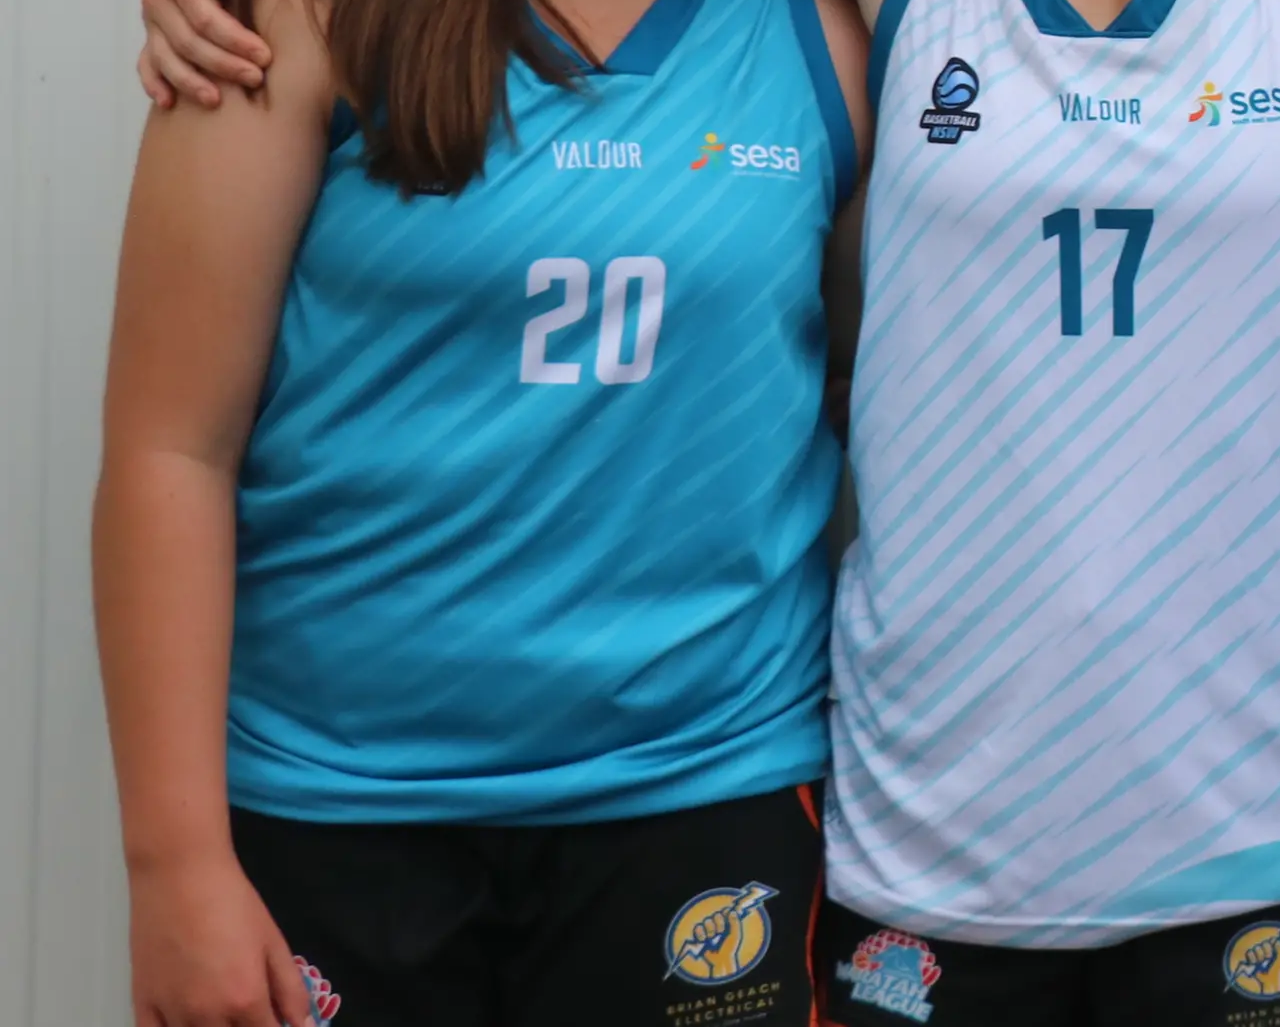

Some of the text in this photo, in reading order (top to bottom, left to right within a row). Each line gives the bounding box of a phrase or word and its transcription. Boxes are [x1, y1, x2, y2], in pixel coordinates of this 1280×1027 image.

[922, 114, 977, 127] BASKETBALL
[1059, 92, 1141, 125] VALOUR
[552, 139, 642, 170] VALOUR
[730, 144, 800, 172] sesa
[1042, 207, 1154, 337] 17
[519, 255, 667, 385] 20
[851, 980, 934, 1023] LEAGUE
